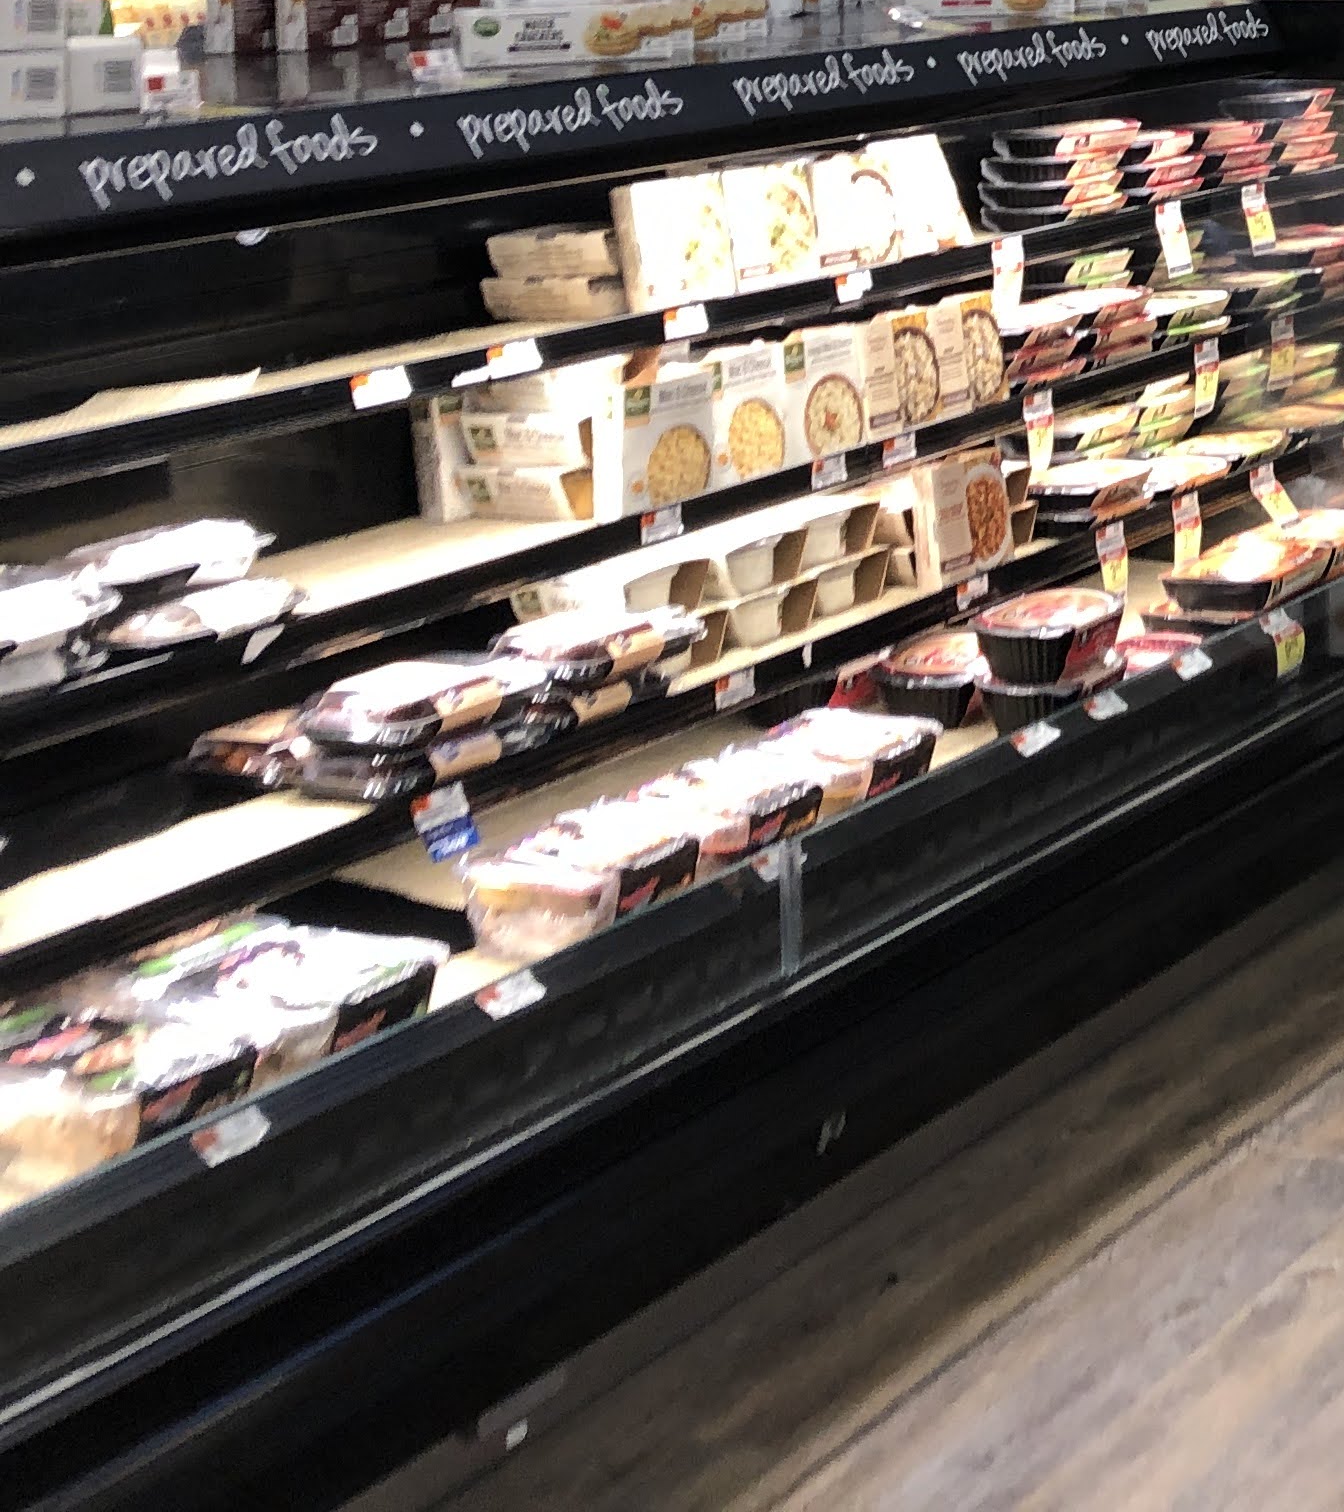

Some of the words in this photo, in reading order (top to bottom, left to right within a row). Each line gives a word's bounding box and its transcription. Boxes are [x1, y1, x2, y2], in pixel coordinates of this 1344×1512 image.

[957, 30, 1053, 86] prepared
[1051, 28, 1106, 68] foods
[1145, 13, 1220, 62] prepared
[1218, 8, 1269, 42] foods
[733, 55, 842, 116] prepared
[841, 48, 915, 94] foods
[457, 87, 600, 159] prepared
[596, 78, 684, 132] foods
[78, 122, 269, 210] prepared
[266, 113, 378, 175] foods
